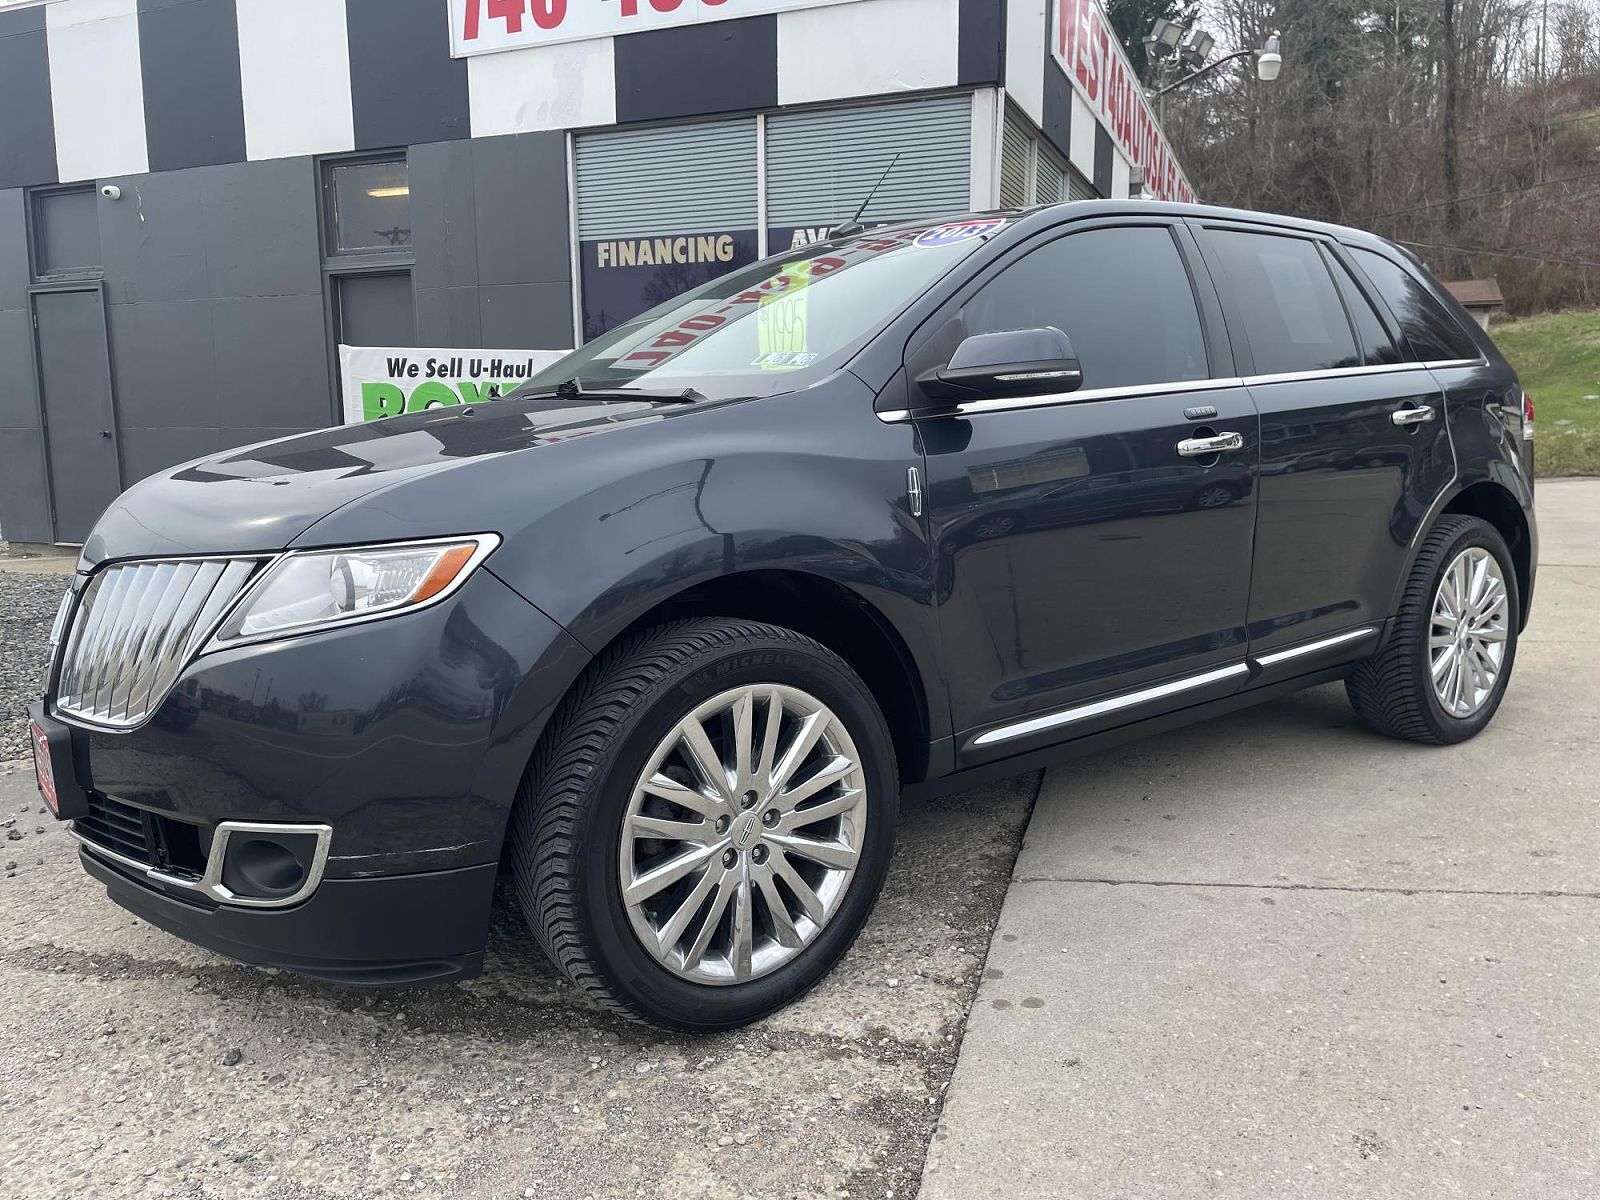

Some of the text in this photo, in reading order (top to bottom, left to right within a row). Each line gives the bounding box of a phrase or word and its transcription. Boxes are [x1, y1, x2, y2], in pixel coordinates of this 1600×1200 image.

[921, 224, 988, 241] 2013
[597, 234, 734, 268] FINANCING
[386, 357, 533, 378] We Sell U-Haul
